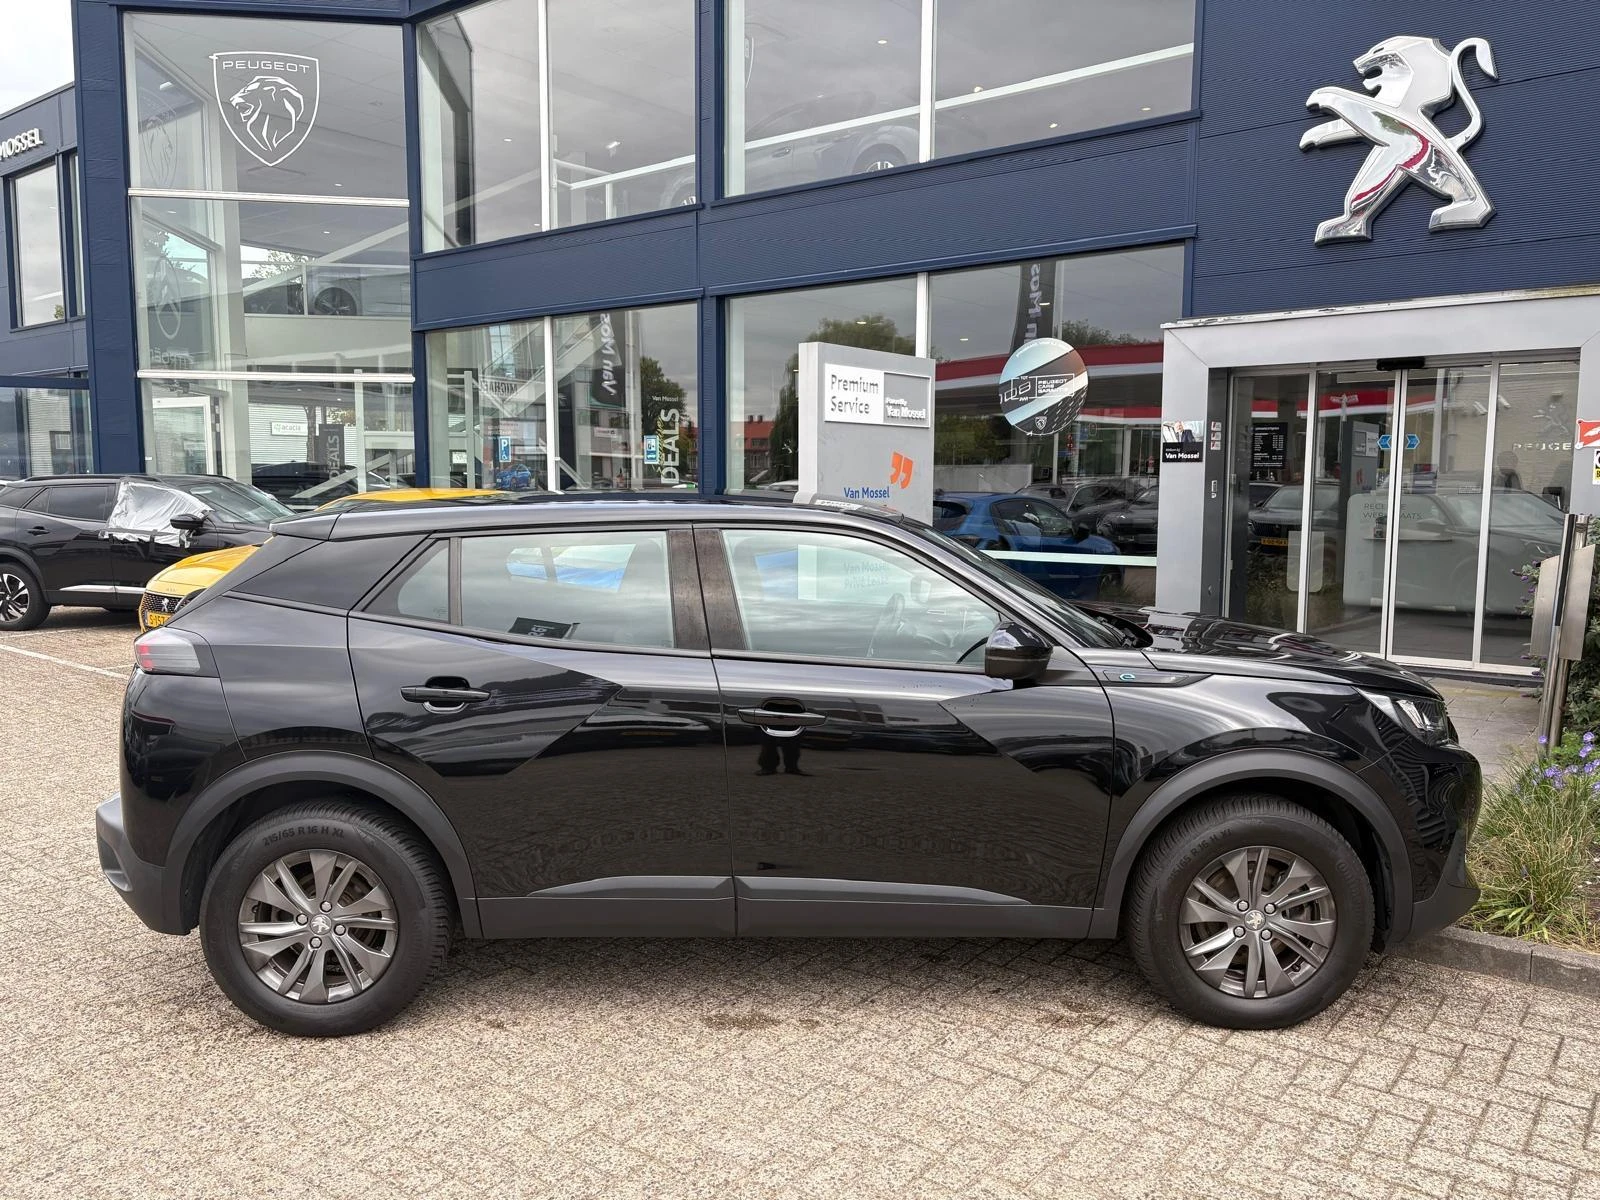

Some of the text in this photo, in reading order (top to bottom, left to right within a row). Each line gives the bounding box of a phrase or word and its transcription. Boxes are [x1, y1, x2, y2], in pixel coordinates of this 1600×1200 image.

[222, 60, 310, 74] PEUGEOT
[830, 374, 879, 395] Premium
[830, 395, 870, 414] Service
[886, 405, 926, 420] Van Mossel
[660, 408, 680, 484] DEALS
[844, 487, 890, 499] Van Mossel
